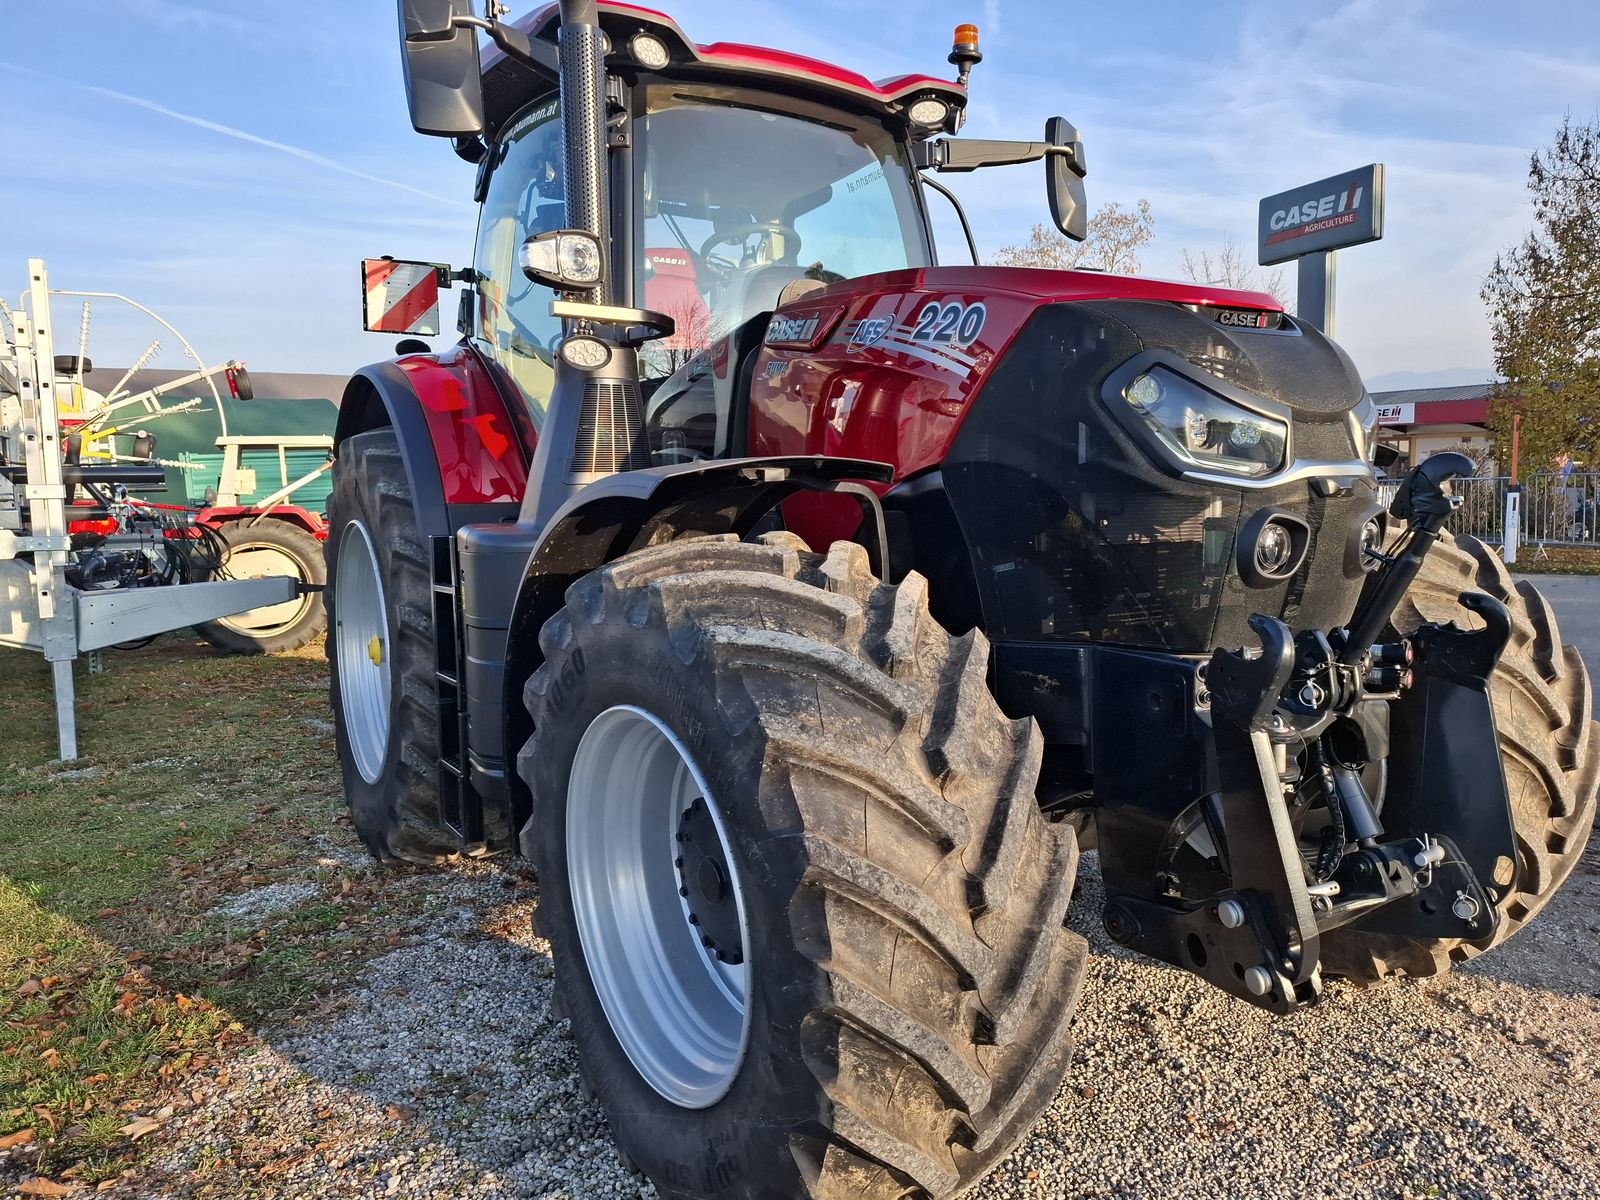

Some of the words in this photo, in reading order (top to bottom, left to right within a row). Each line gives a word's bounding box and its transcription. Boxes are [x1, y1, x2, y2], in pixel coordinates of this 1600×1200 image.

[1270, 195, 1335, 230] CASE
[1304, 214, 1354, 233] AGRICULTURE
[652, 256, 677, 265] CASE
[851, 318, 887, 344] AFS
[910, 301, 987, 346] 220
[1220, 311, 1256, 327] CASE
[766, 319, 806, 341] CASE
